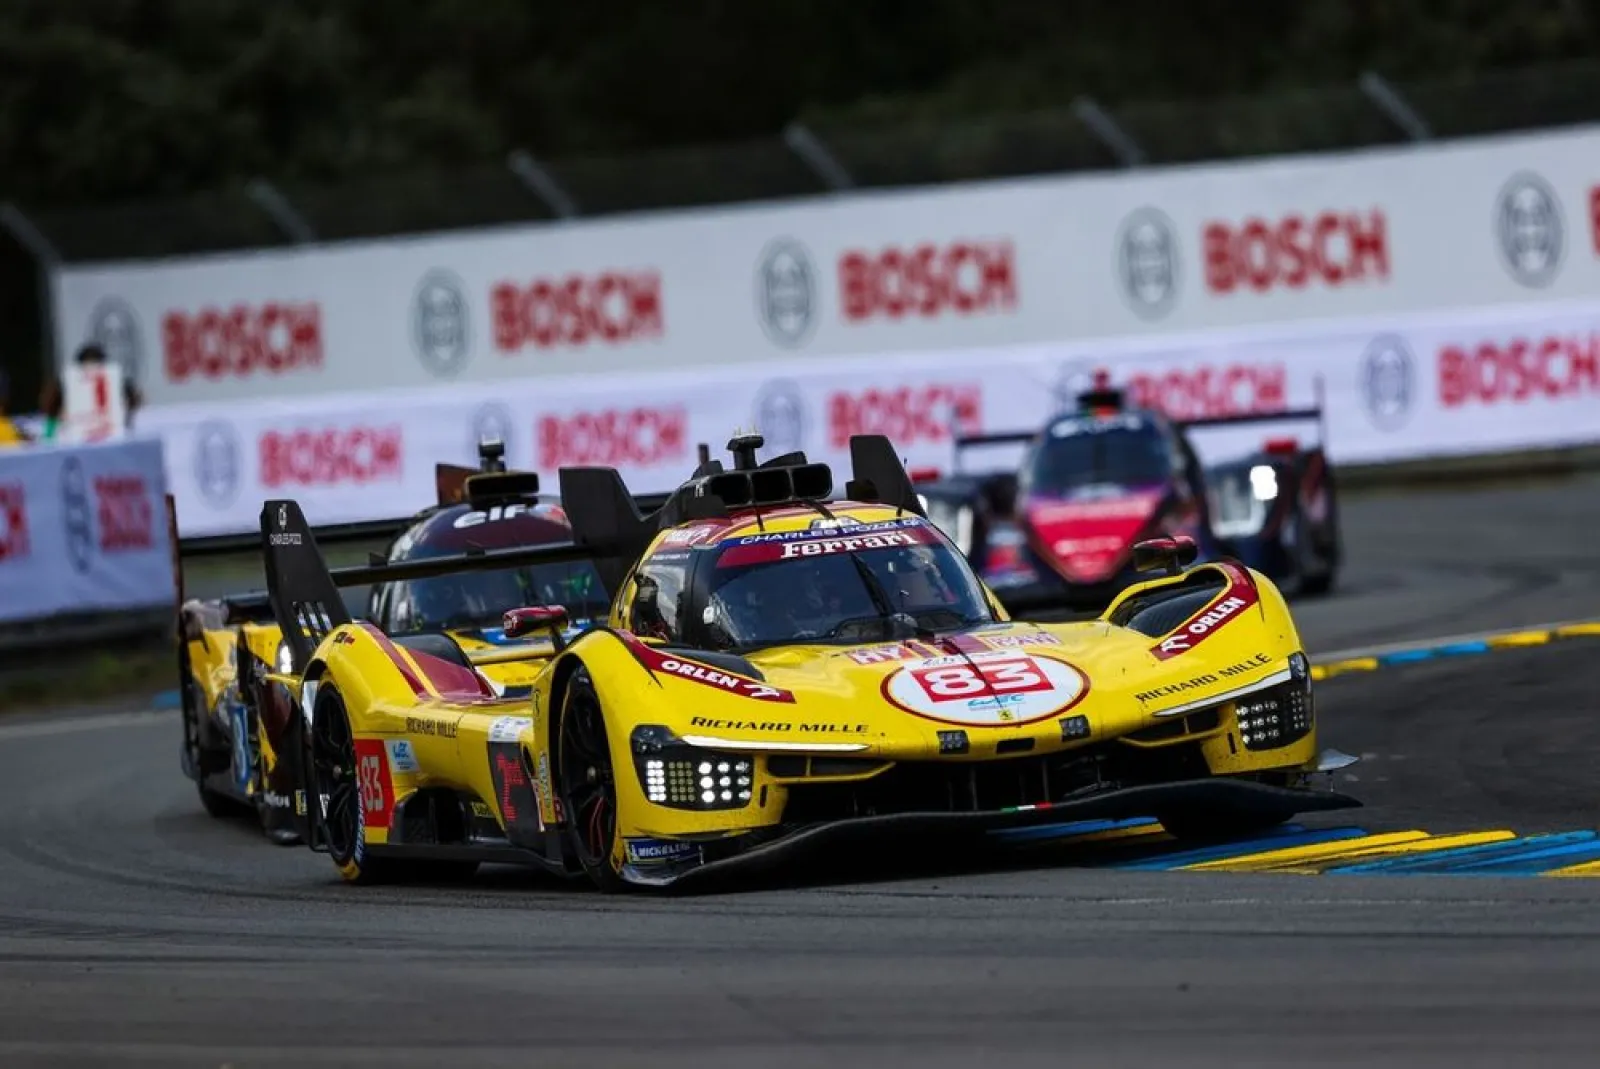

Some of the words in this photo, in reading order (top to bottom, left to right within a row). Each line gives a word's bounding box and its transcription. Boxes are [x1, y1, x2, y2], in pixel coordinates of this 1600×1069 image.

[1205, 214, 1387, 293] BOSCH
[840, 245, 1013, 319] BOSCH
[495, 276, 659, 349] BOSCH
[166, 306, 319, 377] BOSCH
[1438, 338, 1600, 407] BOSCH
[539, 410, 685, 472] BOSCH
[829, 387, 980, 448] BOSCH
[260, 429, 401, 486] BOSCH
[741, 527, 837, 545] CHARLES
[780, 530, 919, 558] Ferrari
[1189, 596, 1246, 635] ORLEN
[661, 660, 739, 689] ORLEN
[923, 661, 1041, 695] 83
[1135, 674, 1219, 703] RICHARD
[1218, 652, 1273, 679] MILLE
[690, 716, 792, 732] RICHARD
[799, 724, 869, 733] MILLE
[361, 756, 384, 812] 83
